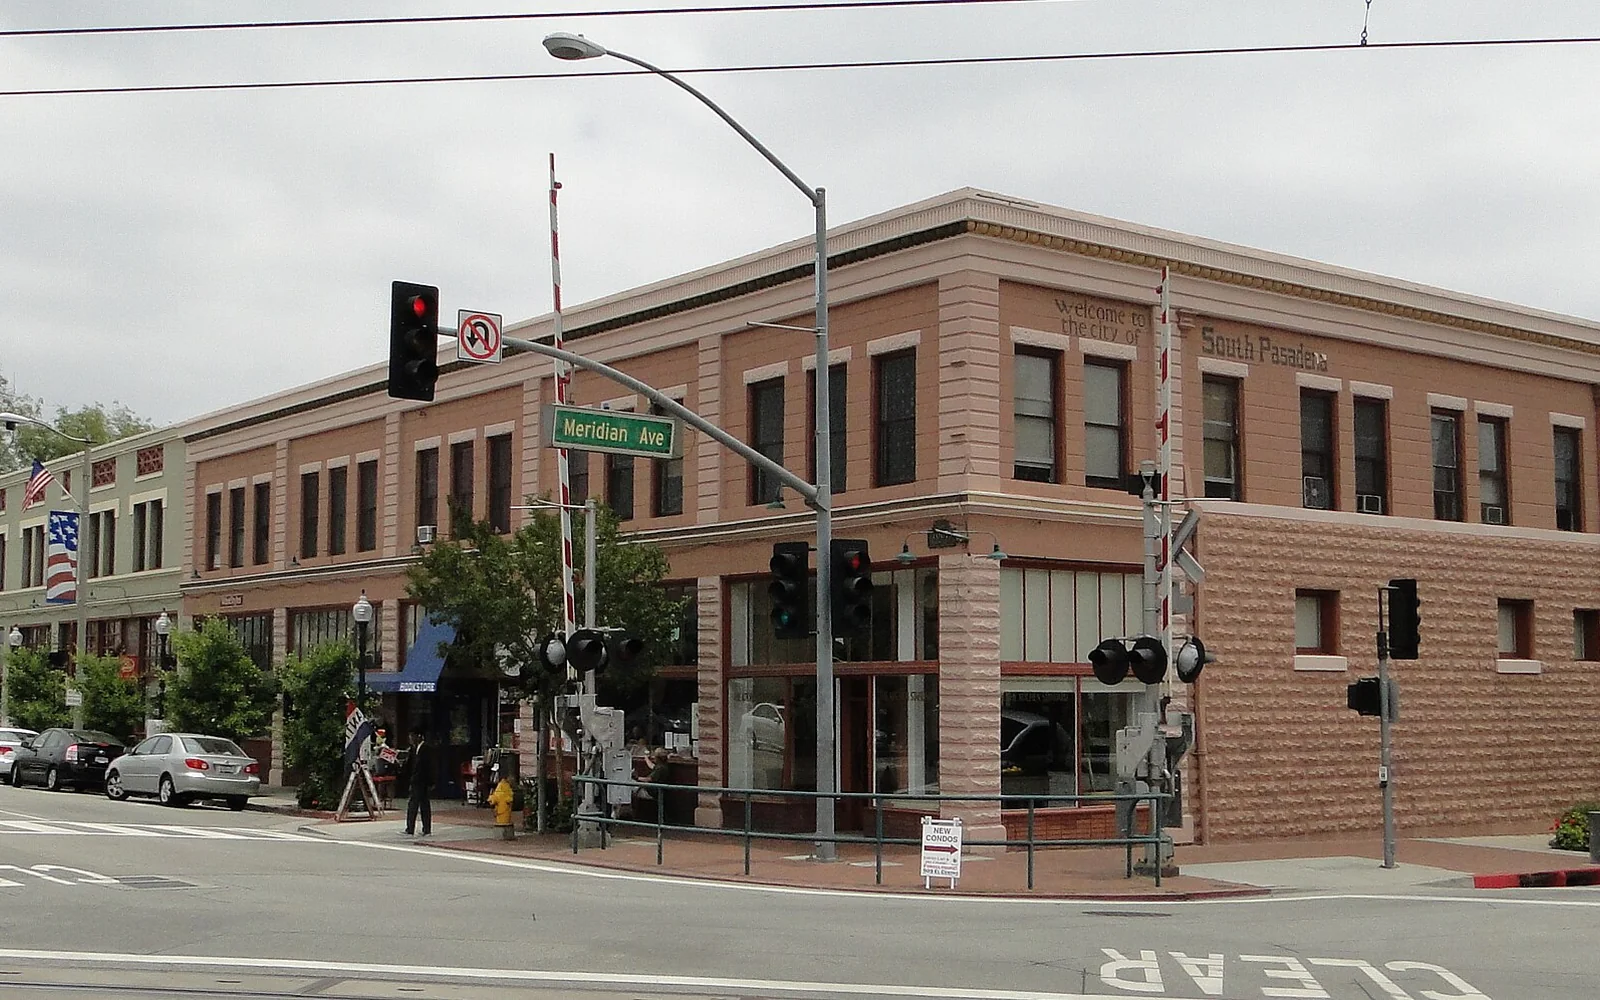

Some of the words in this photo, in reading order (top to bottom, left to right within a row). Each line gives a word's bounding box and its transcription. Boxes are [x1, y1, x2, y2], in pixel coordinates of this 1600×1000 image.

[1061, 315, 1088, 337] the
[1090, 320, 1118, 342] city
[1125, 329, 1141, 345] of
[1131, 311, 1145, 328] to
[1201, 325, 1255, 360] South
[1258, 336, 1329, 372] Pasadena
[564, 419, 628, 442] Meridian
[639, 427, 664, 446] Ave
[400, 682, 436, 691] BOOKSTORE
[925, 834, 959, 843] CONDOS
[1100, 948, 1492, 1000] CLEAR
